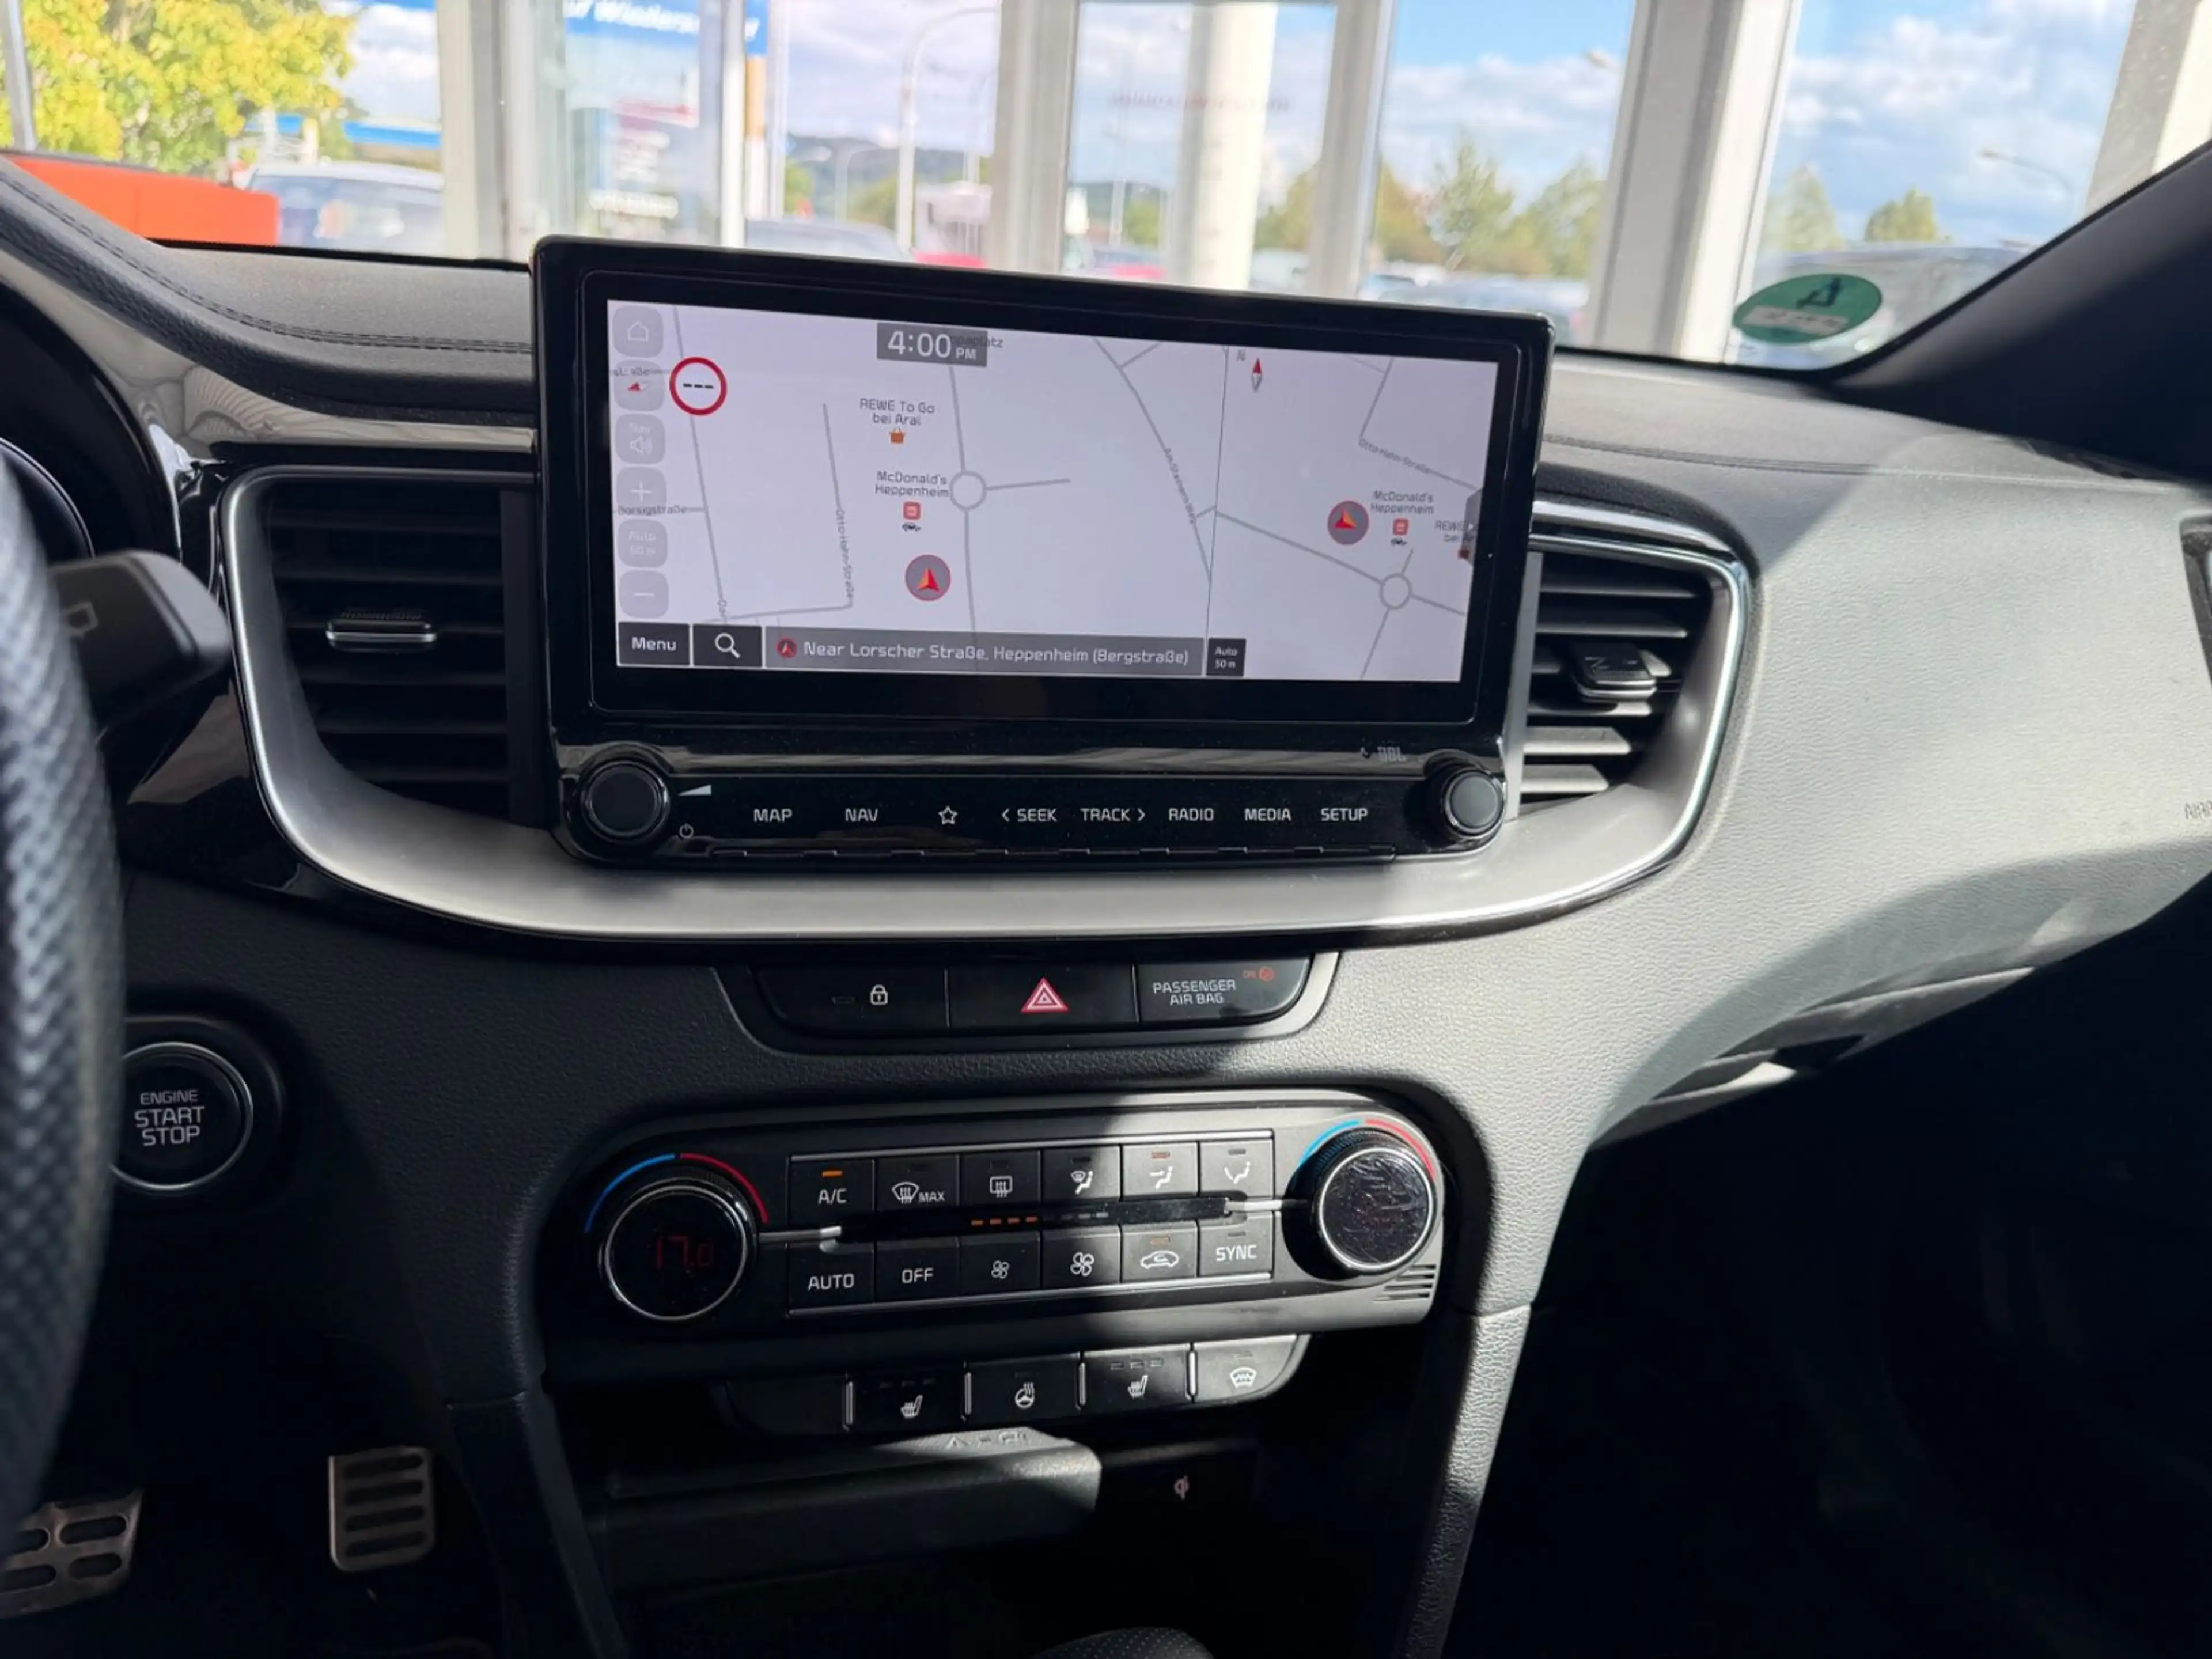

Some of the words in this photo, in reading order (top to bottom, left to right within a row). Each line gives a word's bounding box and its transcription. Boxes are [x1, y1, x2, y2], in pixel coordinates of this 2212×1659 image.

[888, 330, 951, 358] 4:00
[955, 347, 976, 361] PM
[859, 397, 895, 412] REWE
[900, 400, 915, 412] To
[918, 402, 935, 414] Go
[873, 414, 891, 425] bei
[876, 471, 948, 486] McDonald's
[875, 484, 949, 498] Heppenheim
[1373, 489, 1434, 504] McDonald's
[1370, 502, 1434, 515] Heppenheim
[631, 637, 677, 651] Menu
[1214, 646, 1238, 657] Auto
[804, 641, 844, 656] Near
[850, 642, 924, 658] Lorscher
[994, 646, 1089, 663] Heppenheim
[1093, 648, 1189, 666] (Bergstraße)
[753, 808, 792, 822] MAP
[844, 808, 878, 822] NAV
[1017, 808, 1058, 823] SEEK
[1081, 808, 1131, 822] TRACK
[1168, 808, 1214, 822] RADIO
[1245, 808, 1291, 822] MEDIA
[1321, 808, 1368, 822] SETUP
[1153, 979, 1236, 994] PASSENGER
[1170, 994, 1192, 1006] AIR
[1196, 993, 1224, 1004] BAG
[141, 1089, 198, 1105] ENGINE
[134, 1106, 205, 1128] START
[142, 1125, 200, 1146] STOP
[818, 1188, 847, 1205] A/C
[919, 1192, 945, 1204] MAX
[1215, 1244, 1257, 1263] SYNC
[809, 1274, 855, 1290] AUTO
[902, 1267, 935, 1283] OFF
